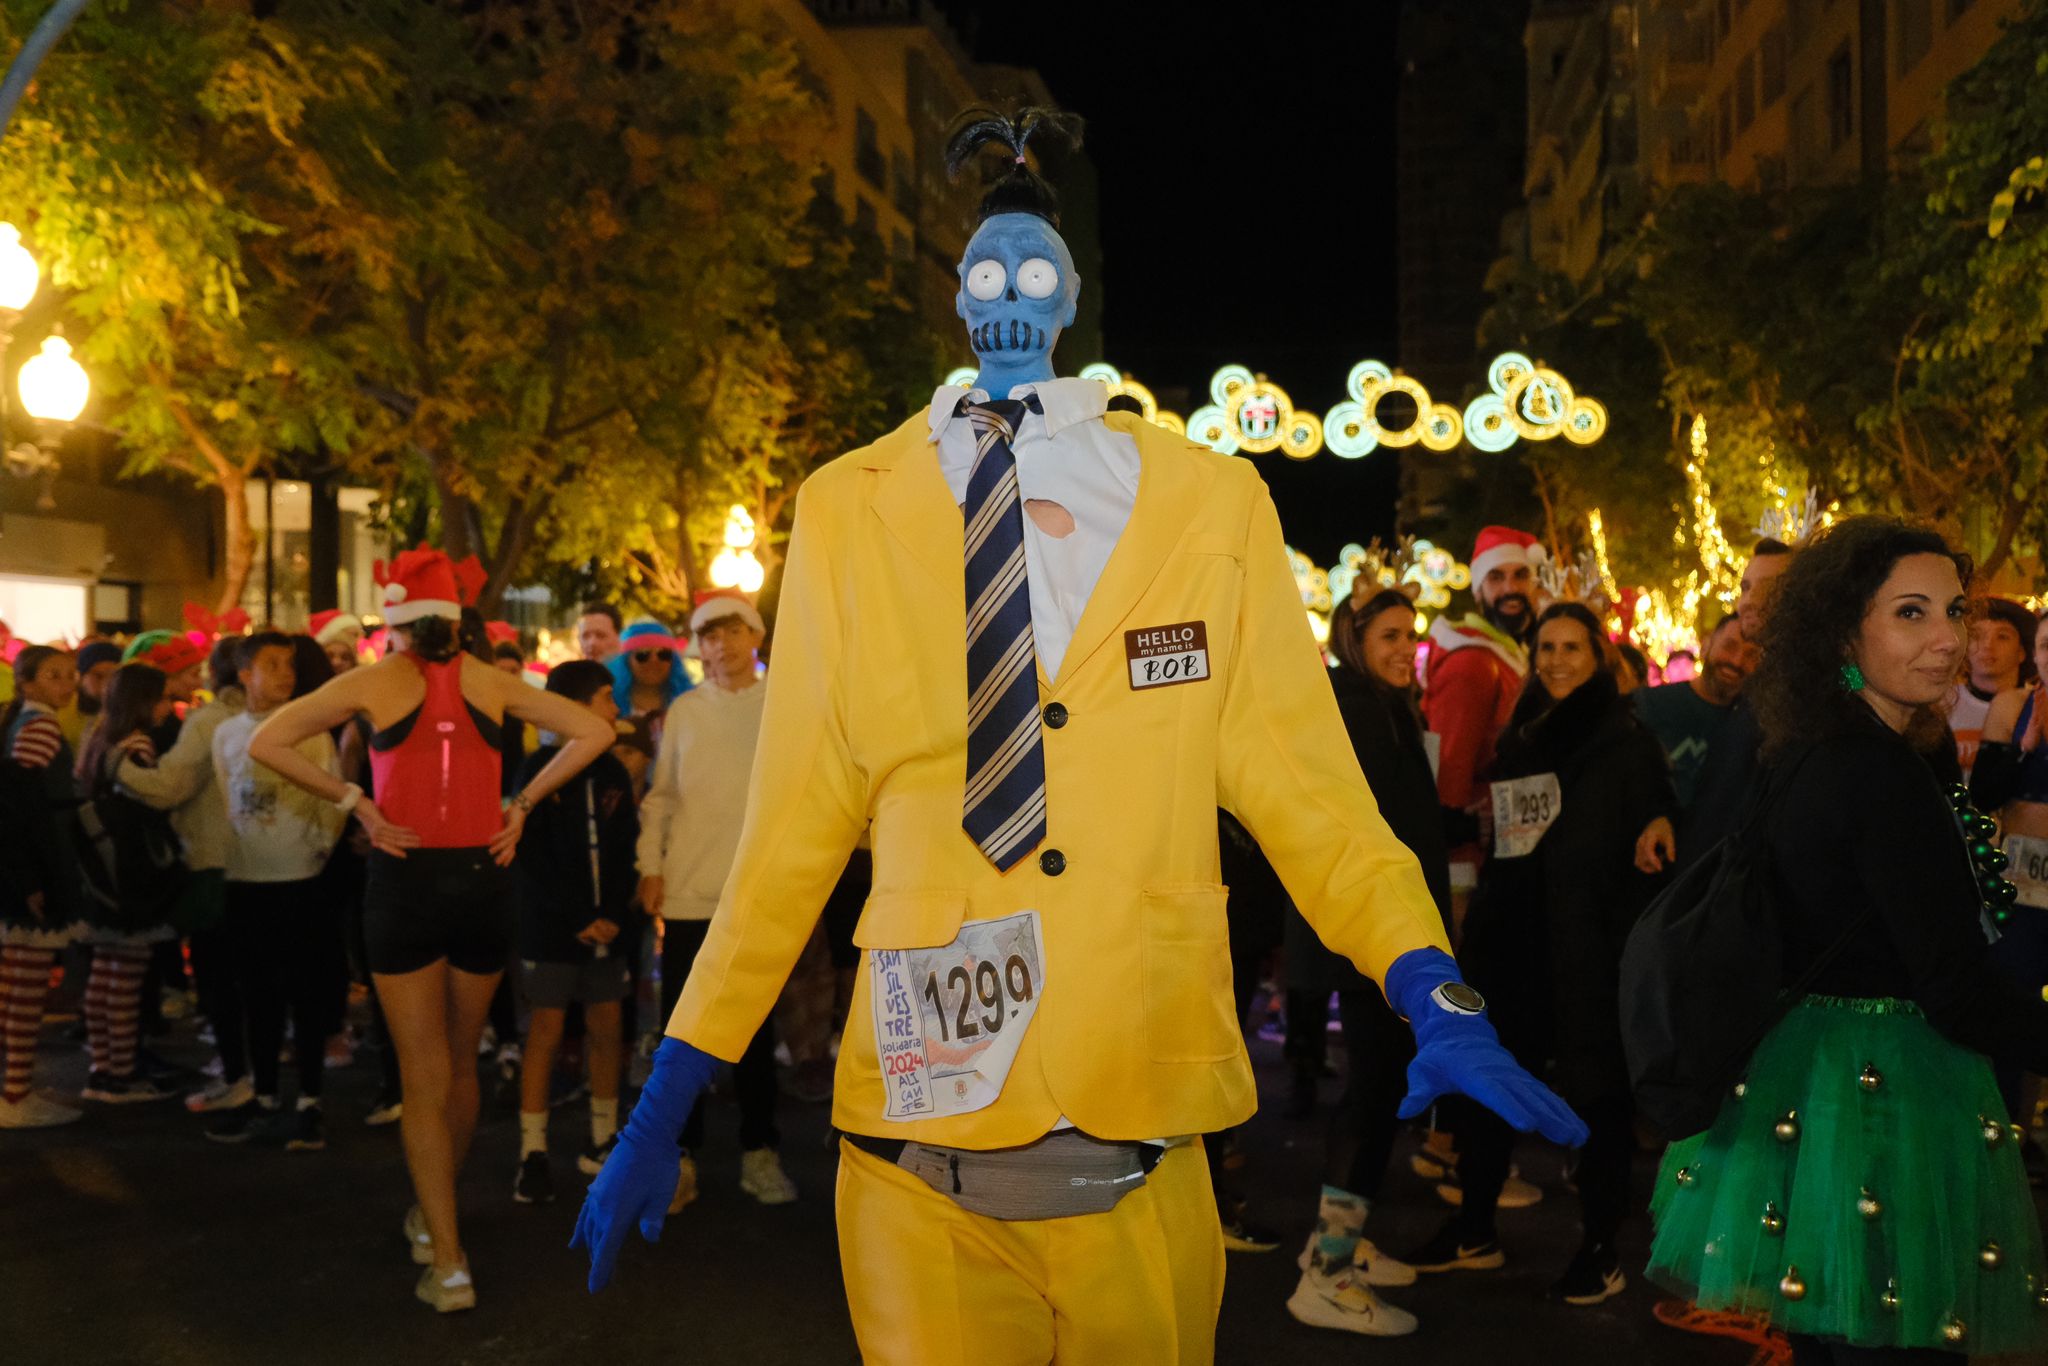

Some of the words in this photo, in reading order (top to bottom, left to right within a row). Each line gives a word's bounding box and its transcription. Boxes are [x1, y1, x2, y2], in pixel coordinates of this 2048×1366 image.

[1137, 627, 1194, 647] HELLO
[1141, 647, 1155, 656] my
[1157, 643, 1183, 653] name
[1185, 641, 1194, 649] is
[1143, 654, 1199, 682] BOB
[1520, 791, 1551, 825] 293
[877, 949, 902, 973] SAN
[885, 991, 911, 1015] VES
[885, 1015, 914, 1037] TRE
[882, 1038, 922, 1054] solidaria
[885, 1051, 925, 1076] 2024
[899, 1072, 920, 1089] ALI
[901, 1085, 924, 1102] CAN
